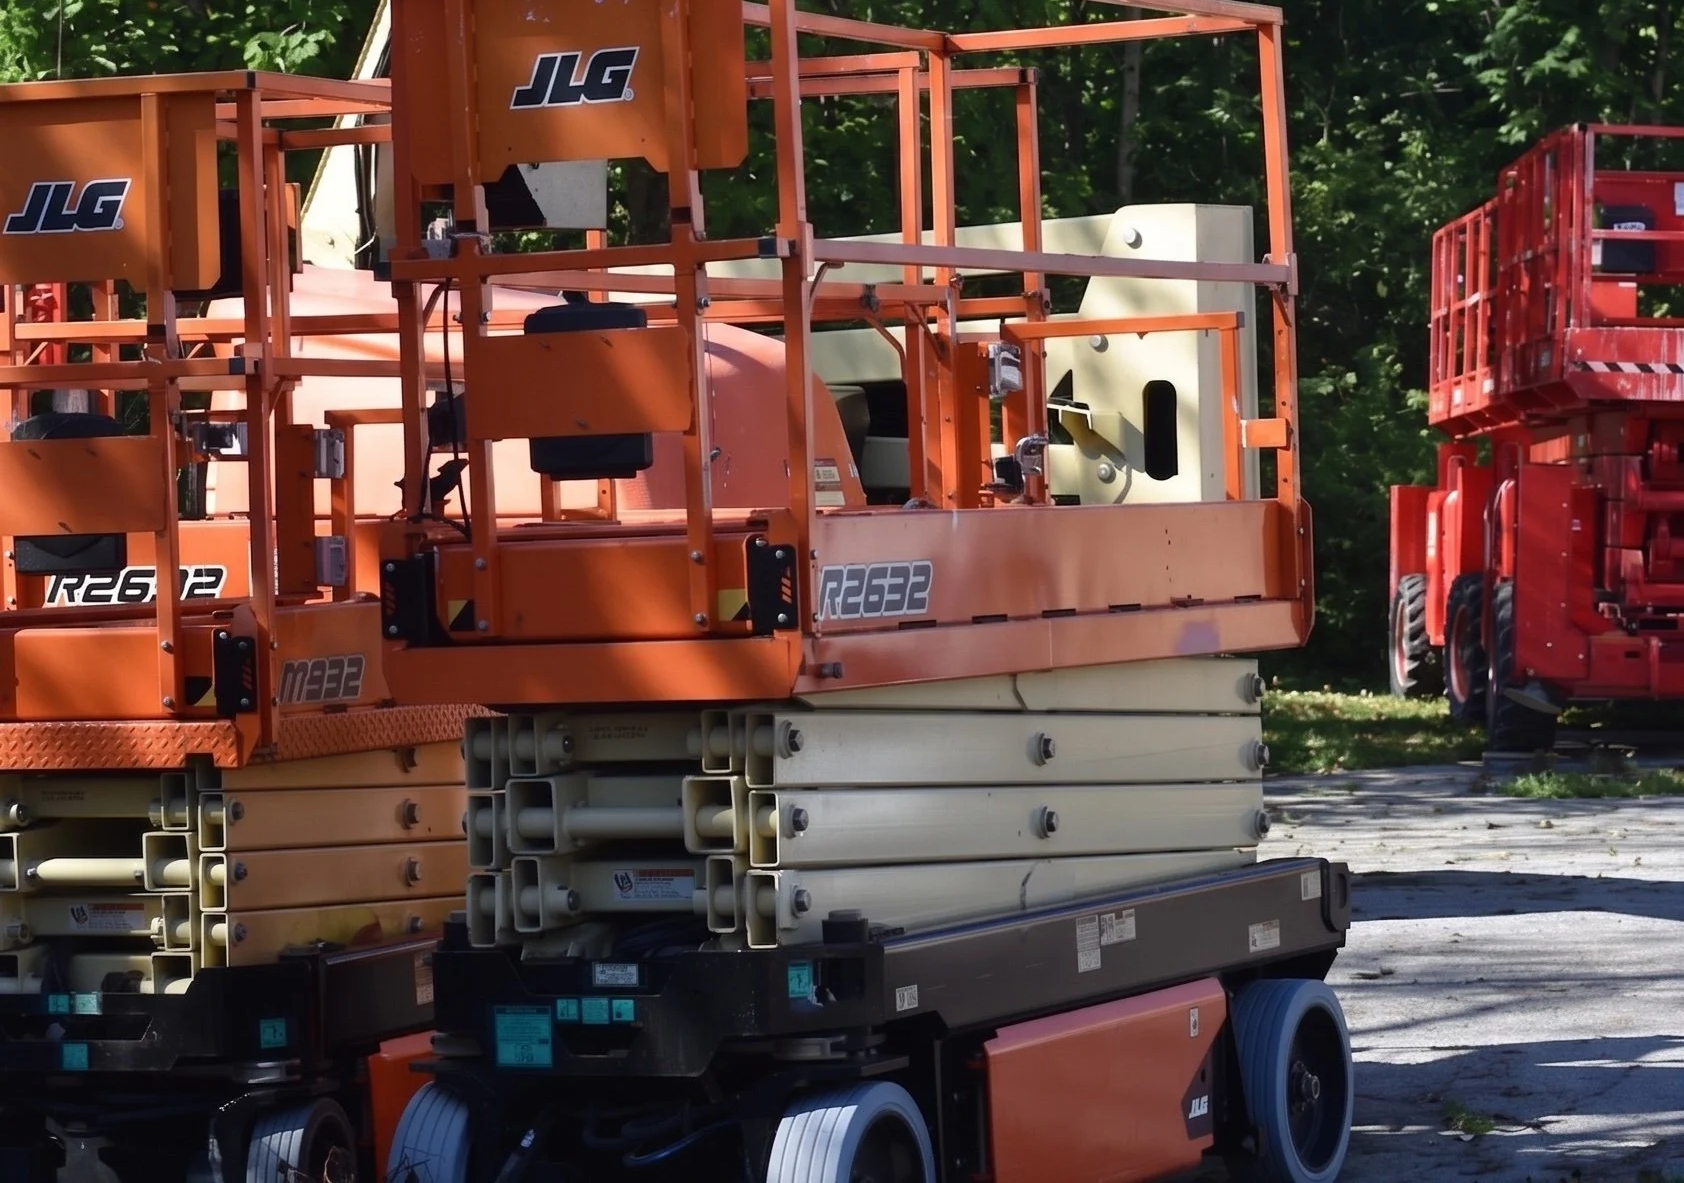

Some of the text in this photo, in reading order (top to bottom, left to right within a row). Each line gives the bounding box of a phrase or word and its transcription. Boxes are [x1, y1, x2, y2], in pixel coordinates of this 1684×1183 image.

[510, 46, 640, 109] JLG
[3, 178, 132, 234] JLG
[819, 561, 933, 620] R2632
[279, 654, 365, 705] M932
[1189, 1095, 1208, 1119] JLG
